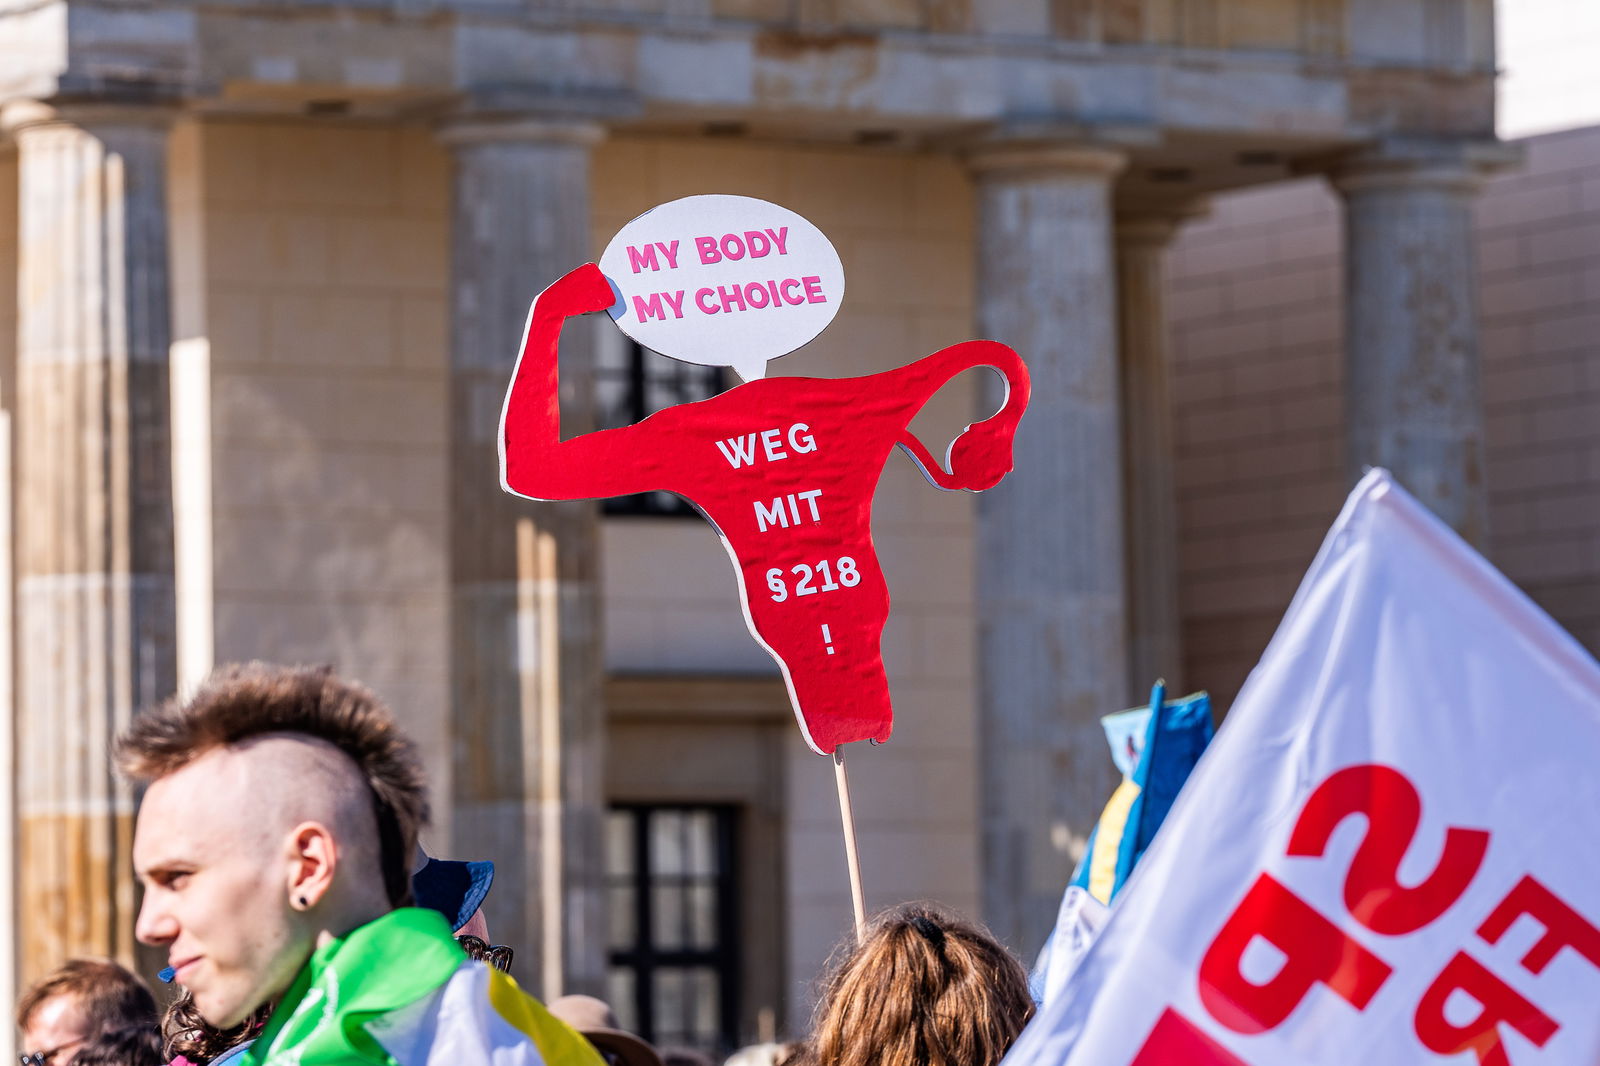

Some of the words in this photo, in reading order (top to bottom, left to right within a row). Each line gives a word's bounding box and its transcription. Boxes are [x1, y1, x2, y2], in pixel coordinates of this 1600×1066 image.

[626, 240, 679, 274] MY
[694, 227, 789, 265] BODY
[632, 290, 684, 323] MY
[695, 276, 827, 315] CHOICE
[715, 423, 818, 469] WEG
[753, 489, 823, 532] MIT
[821, 623, 835, 655] !
